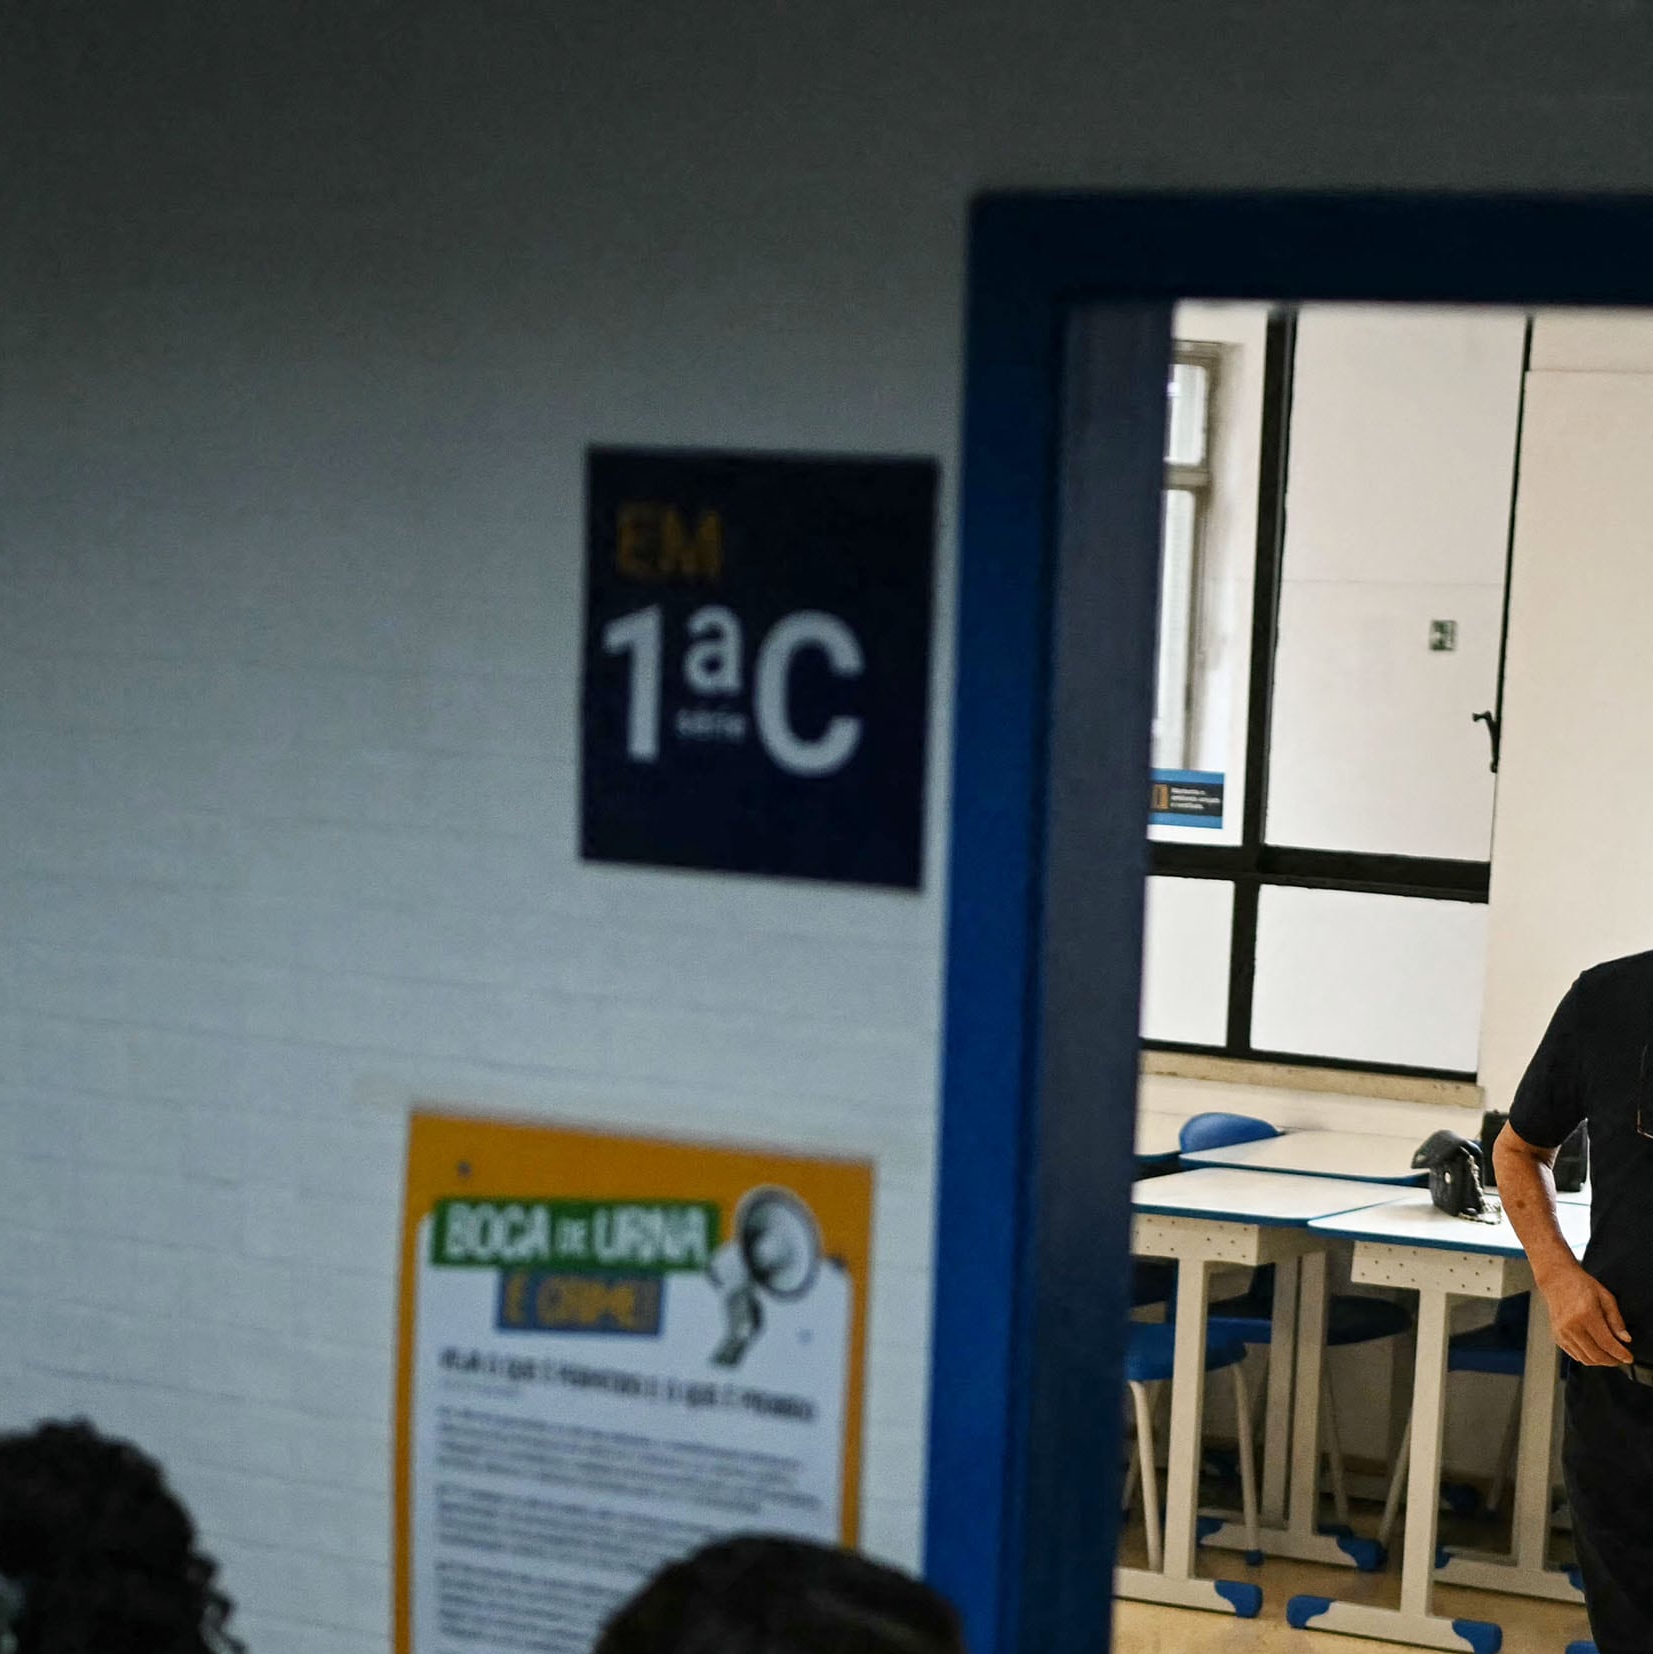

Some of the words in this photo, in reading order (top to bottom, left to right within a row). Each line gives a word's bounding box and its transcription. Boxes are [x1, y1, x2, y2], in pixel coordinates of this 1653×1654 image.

[616, 505, 722, 578] EM
[447, 1203, 548, 1260] BOCA
[594, 1206, 708, 1265] URNA
